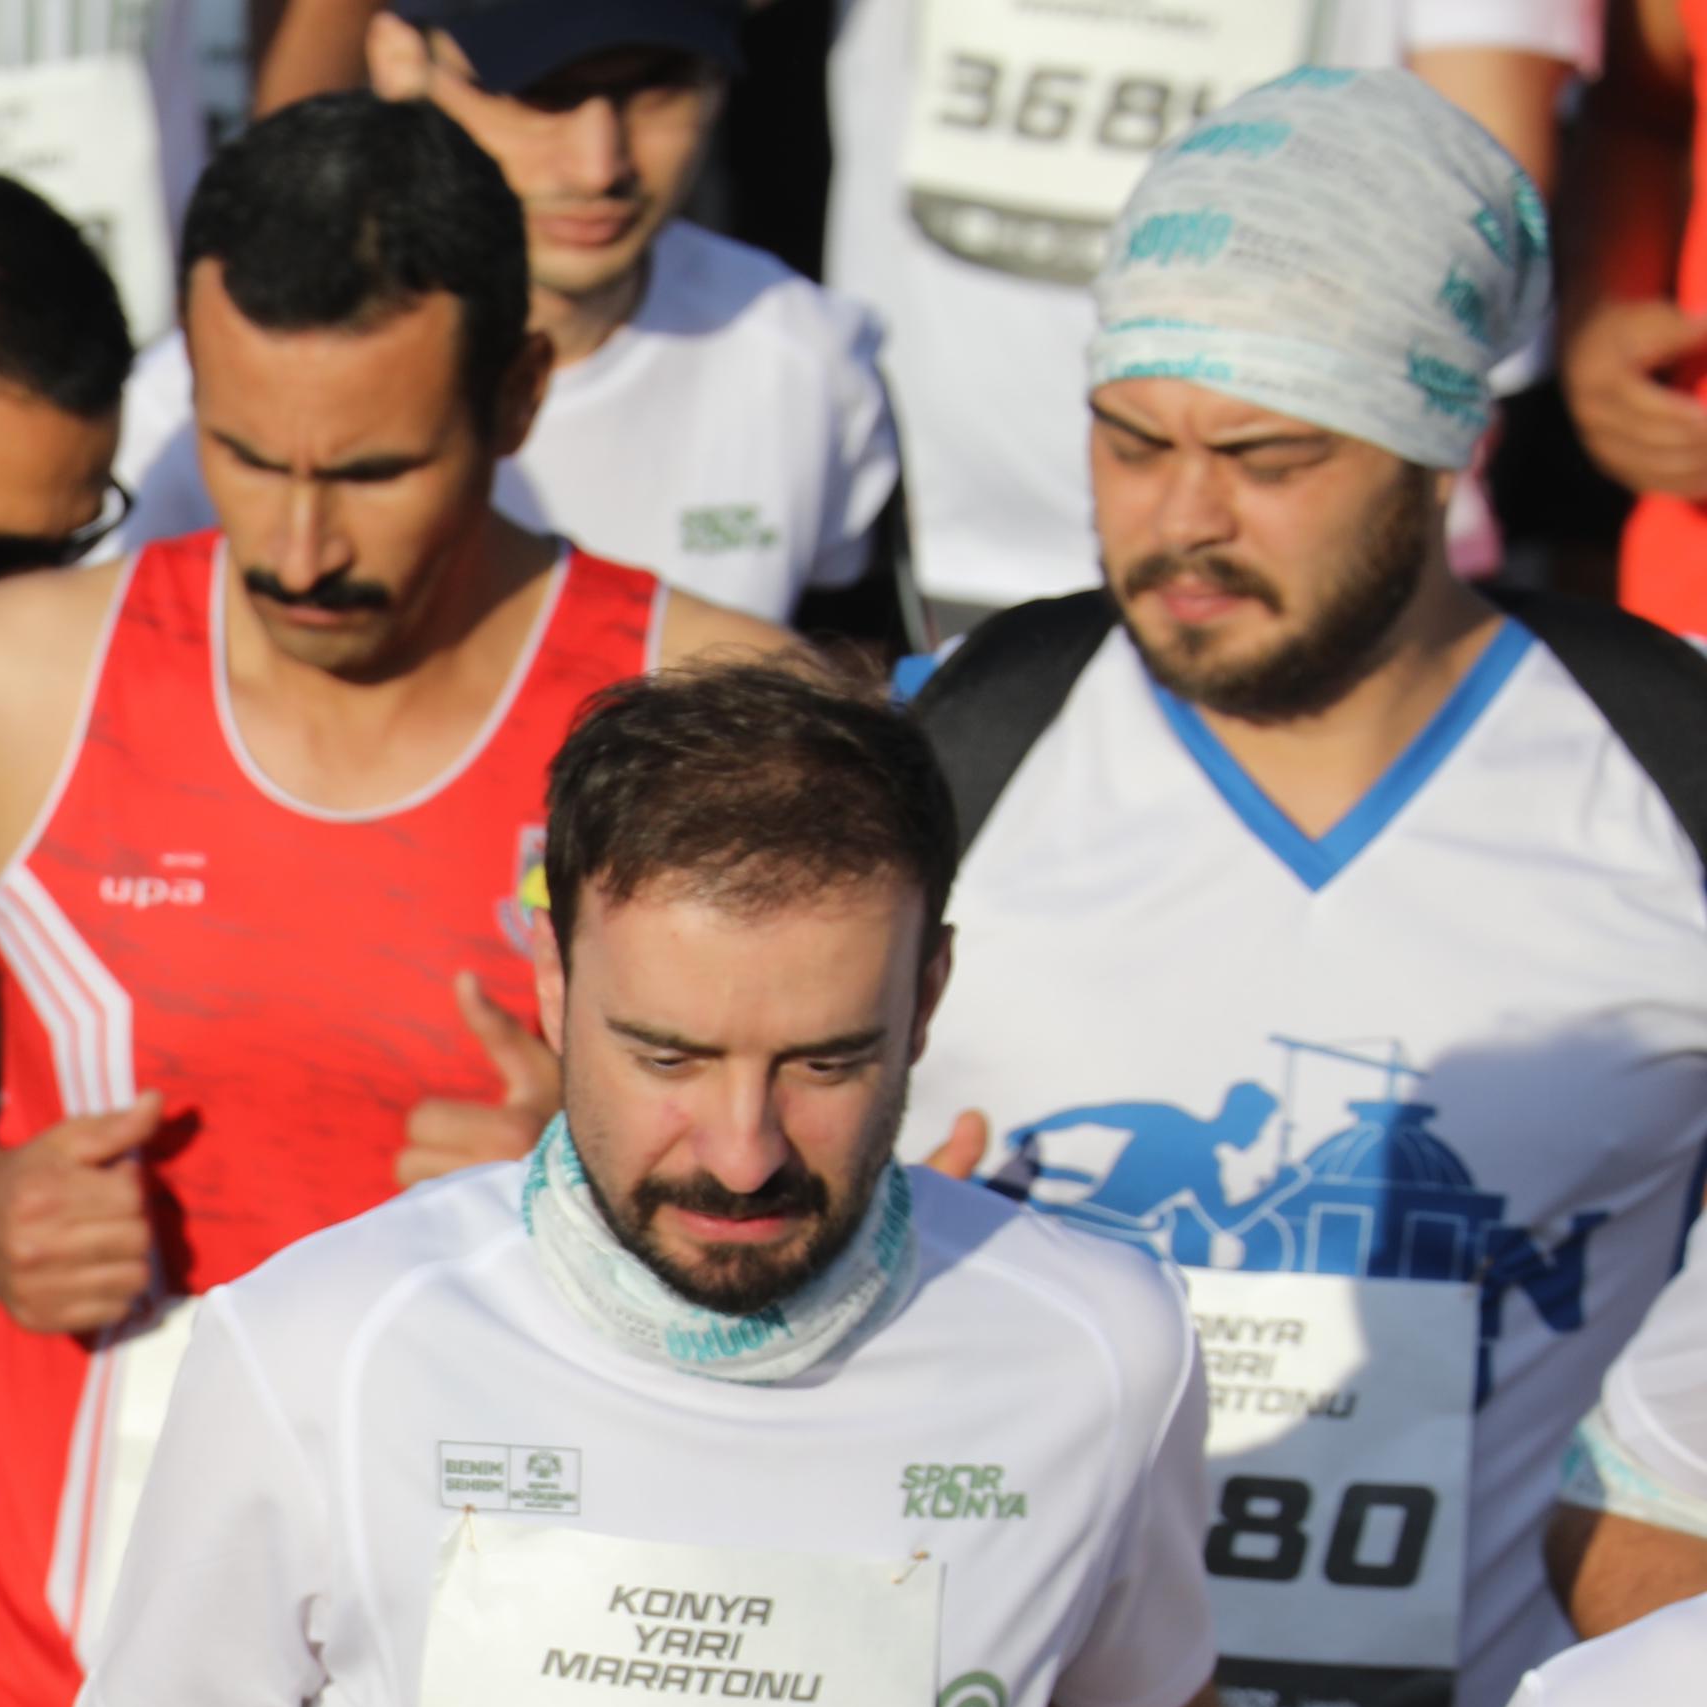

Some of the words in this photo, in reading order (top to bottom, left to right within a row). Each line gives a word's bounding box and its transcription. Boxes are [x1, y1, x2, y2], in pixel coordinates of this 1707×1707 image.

[900, 1464, 1005, 1497] SPOR
[902, 1484, 1029, 1519] KONYA
[608, 1584, 774, 1626] KONYA
[634, 1624, 743, 1662] YARI
[541, 1649, 823, 1703] MARATONU
